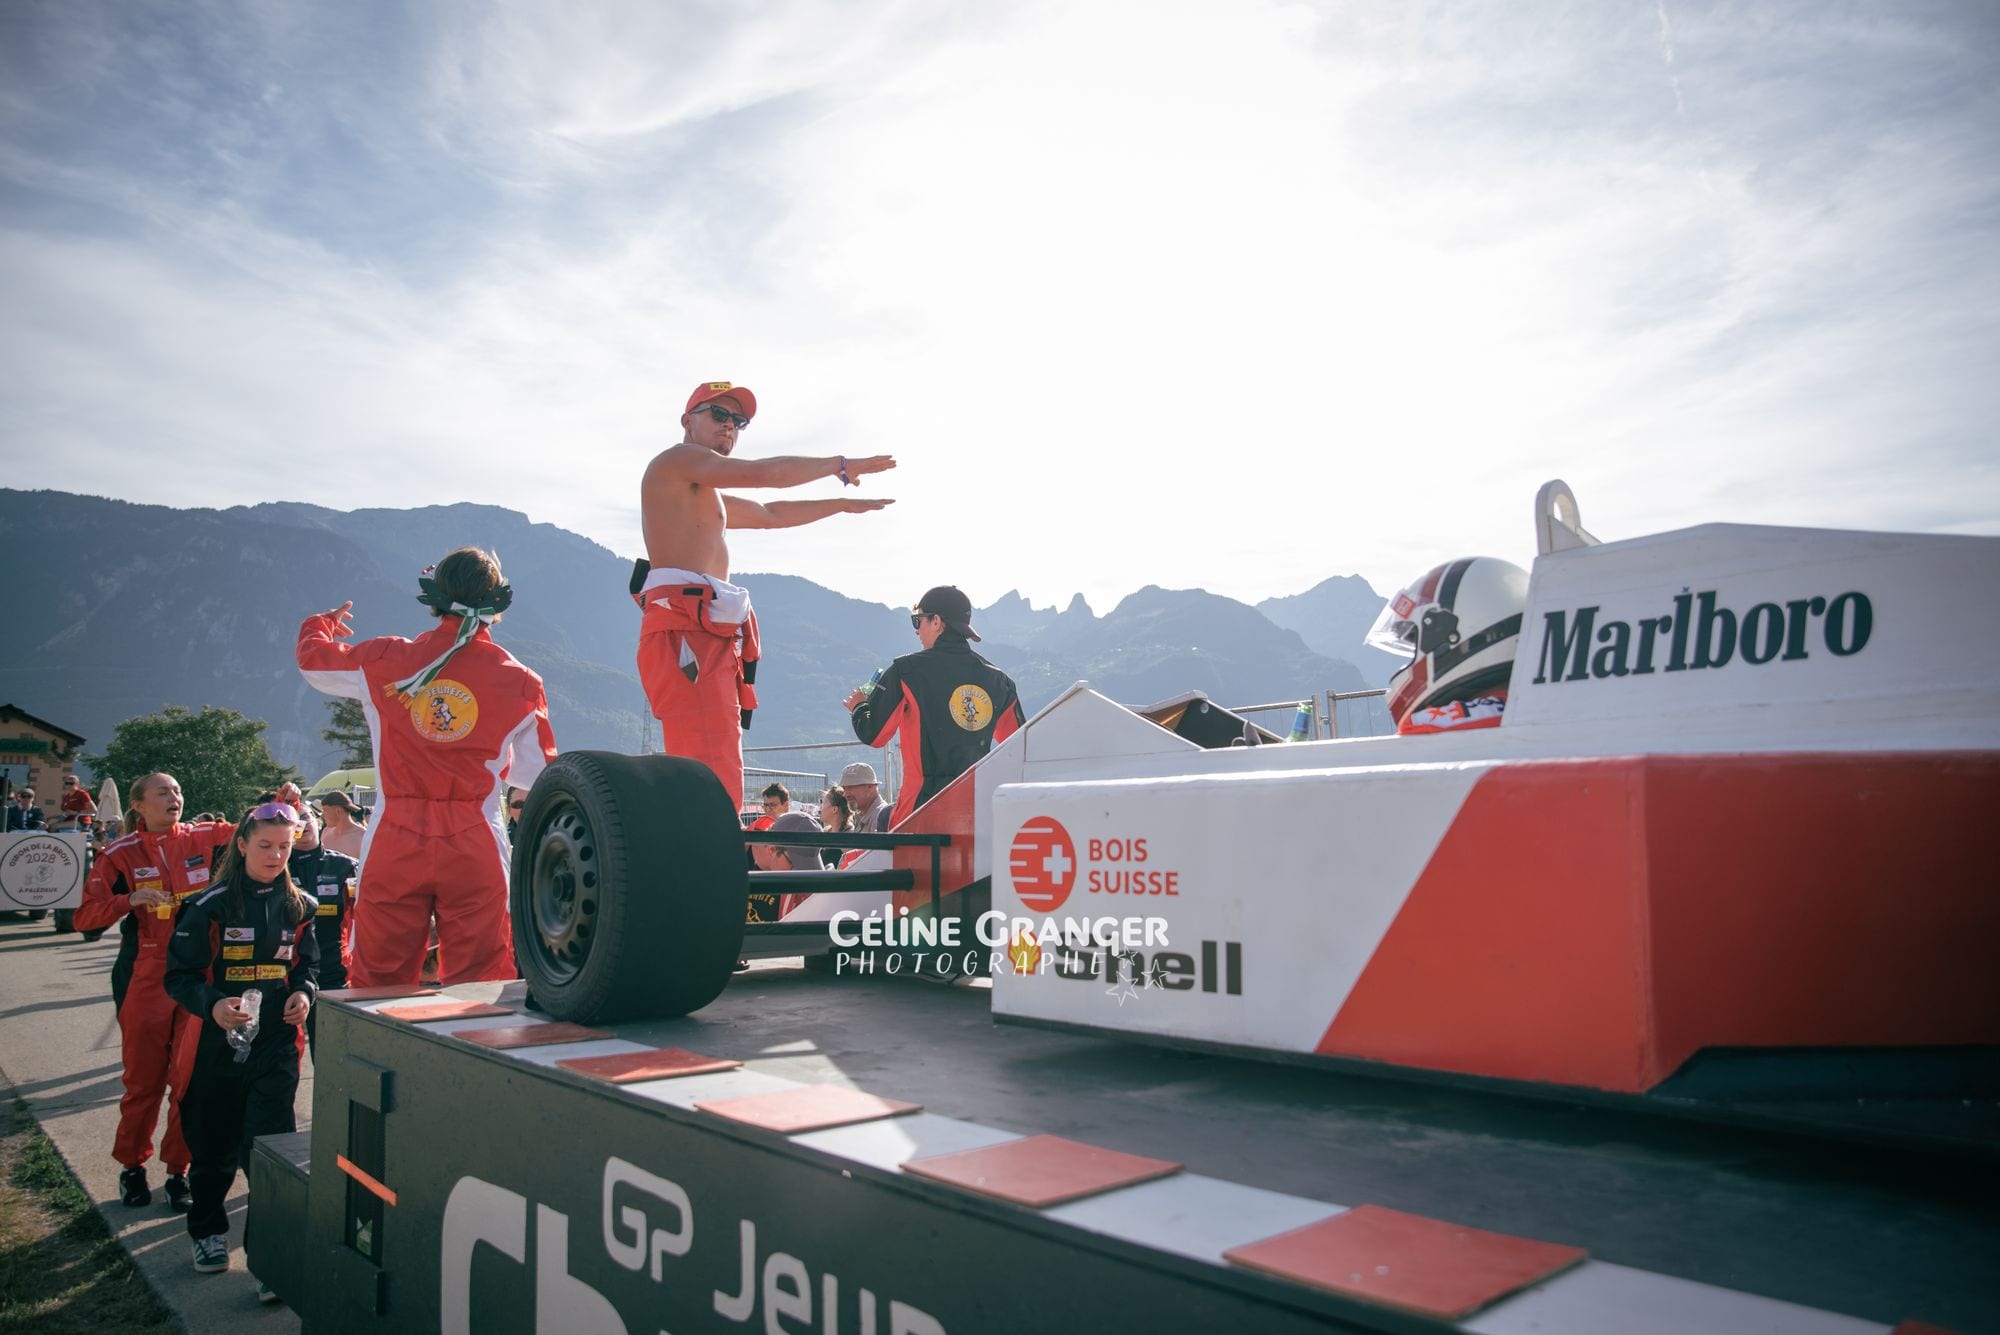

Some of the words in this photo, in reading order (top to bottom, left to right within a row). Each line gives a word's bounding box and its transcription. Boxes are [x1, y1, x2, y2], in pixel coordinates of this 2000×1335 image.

[1532, 590, 1873, 685] Marlboro
[30, 843, 41, 851] DE
[1088, 838, 1148, 862] BOIS
[1088, 870, 1180, 896] SUISSE
[1054, 931, 1243, 996] Shell
[603, 1156, 694, 1282] GP
